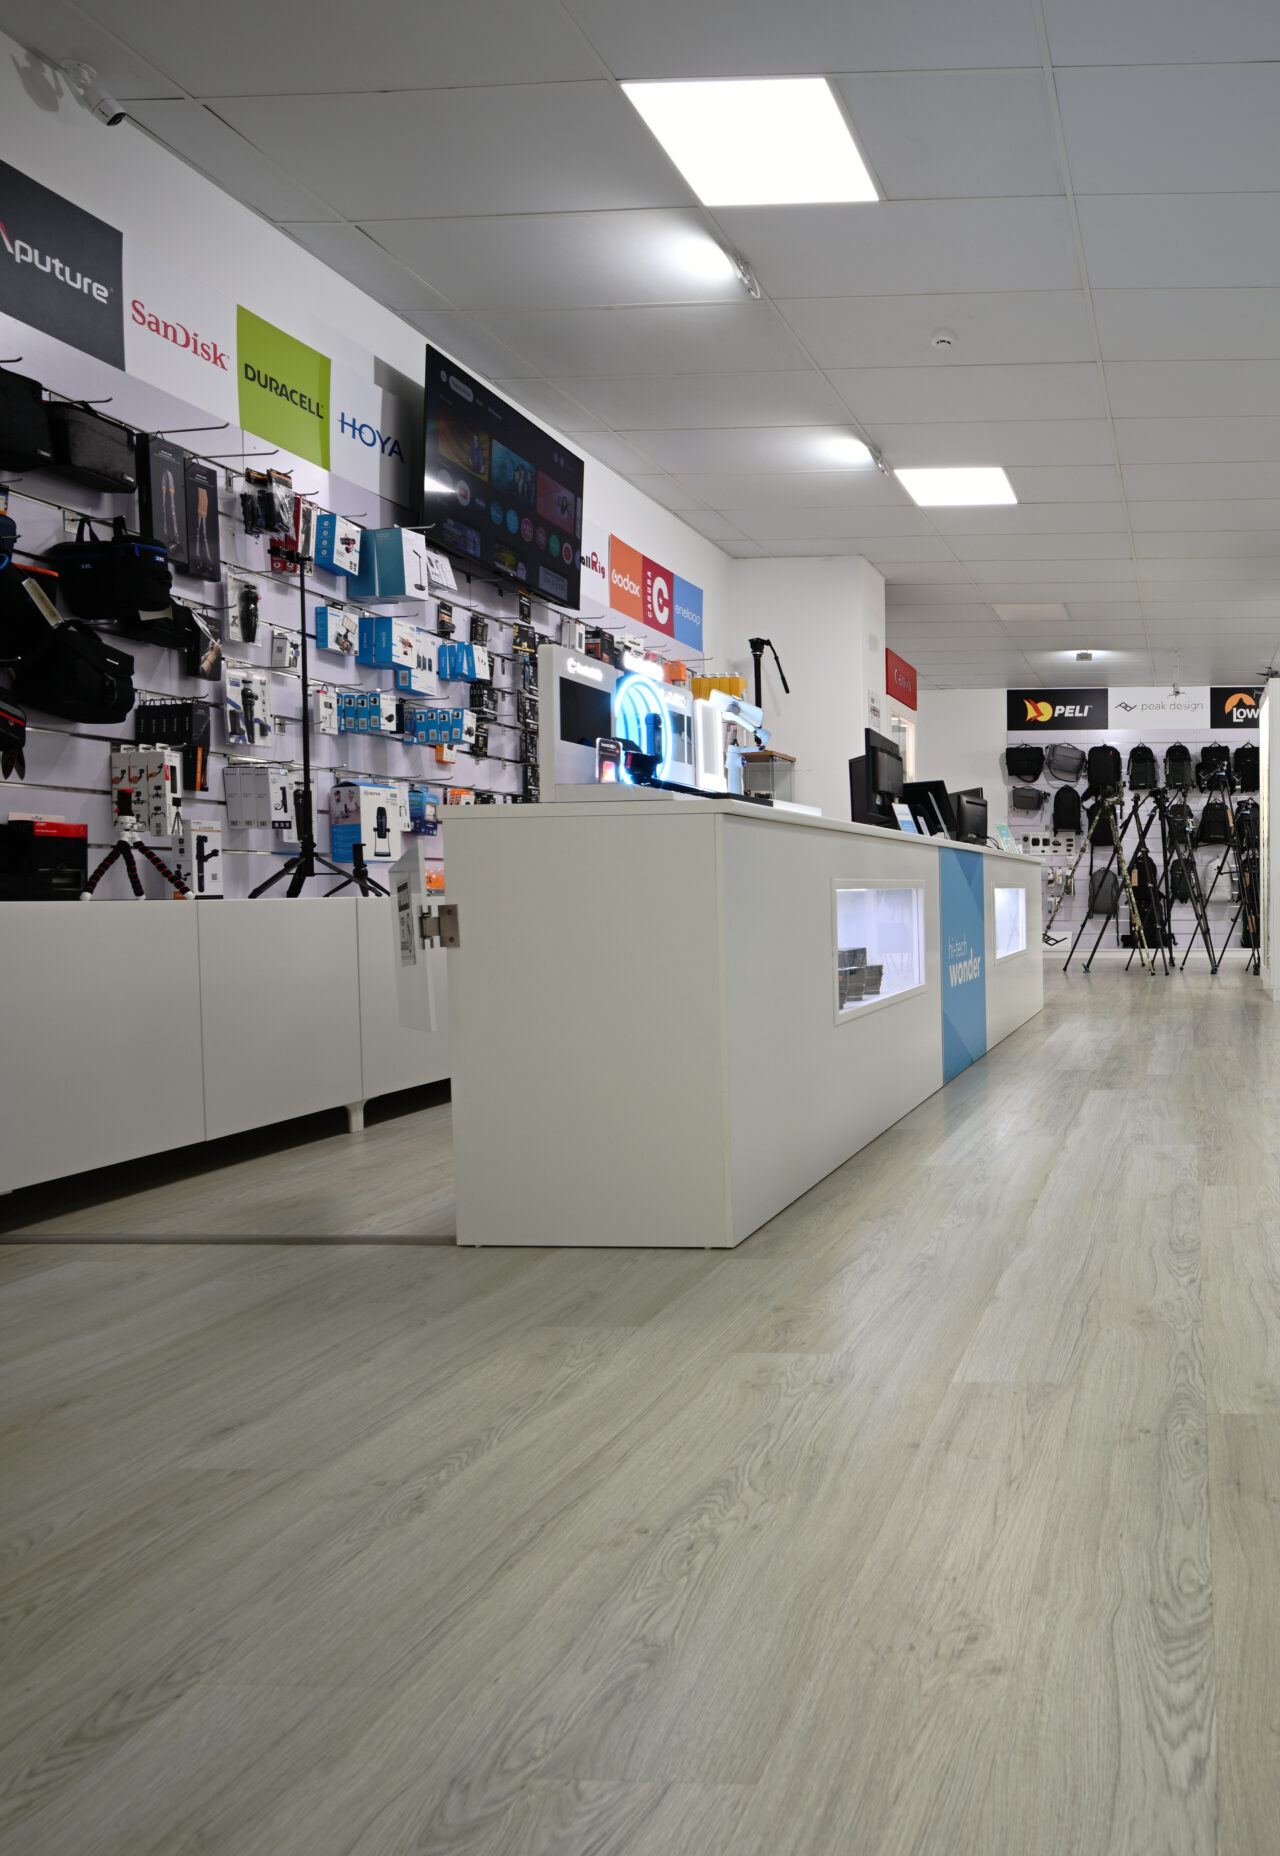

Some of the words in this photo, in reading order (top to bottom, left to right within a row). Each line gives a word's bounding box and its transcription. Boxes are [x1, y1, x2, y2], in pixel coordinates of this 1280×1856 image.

[131, 299, 228, 371] SanDisk
[244, 363, 324, 419] DURACELL
[337, 412, 405, 463] HOYA
[611, 569, 640, 597] Godox
[674, 604, 701, 626] eneloop
[1054, 705, 1089, 717] PELI
[1141, 701, 1166, 711] peak
[1169, 701, 1204, 712] design
[1232, 707, 1259, 722] LOW
[949, 947, 981, 987] wonder
